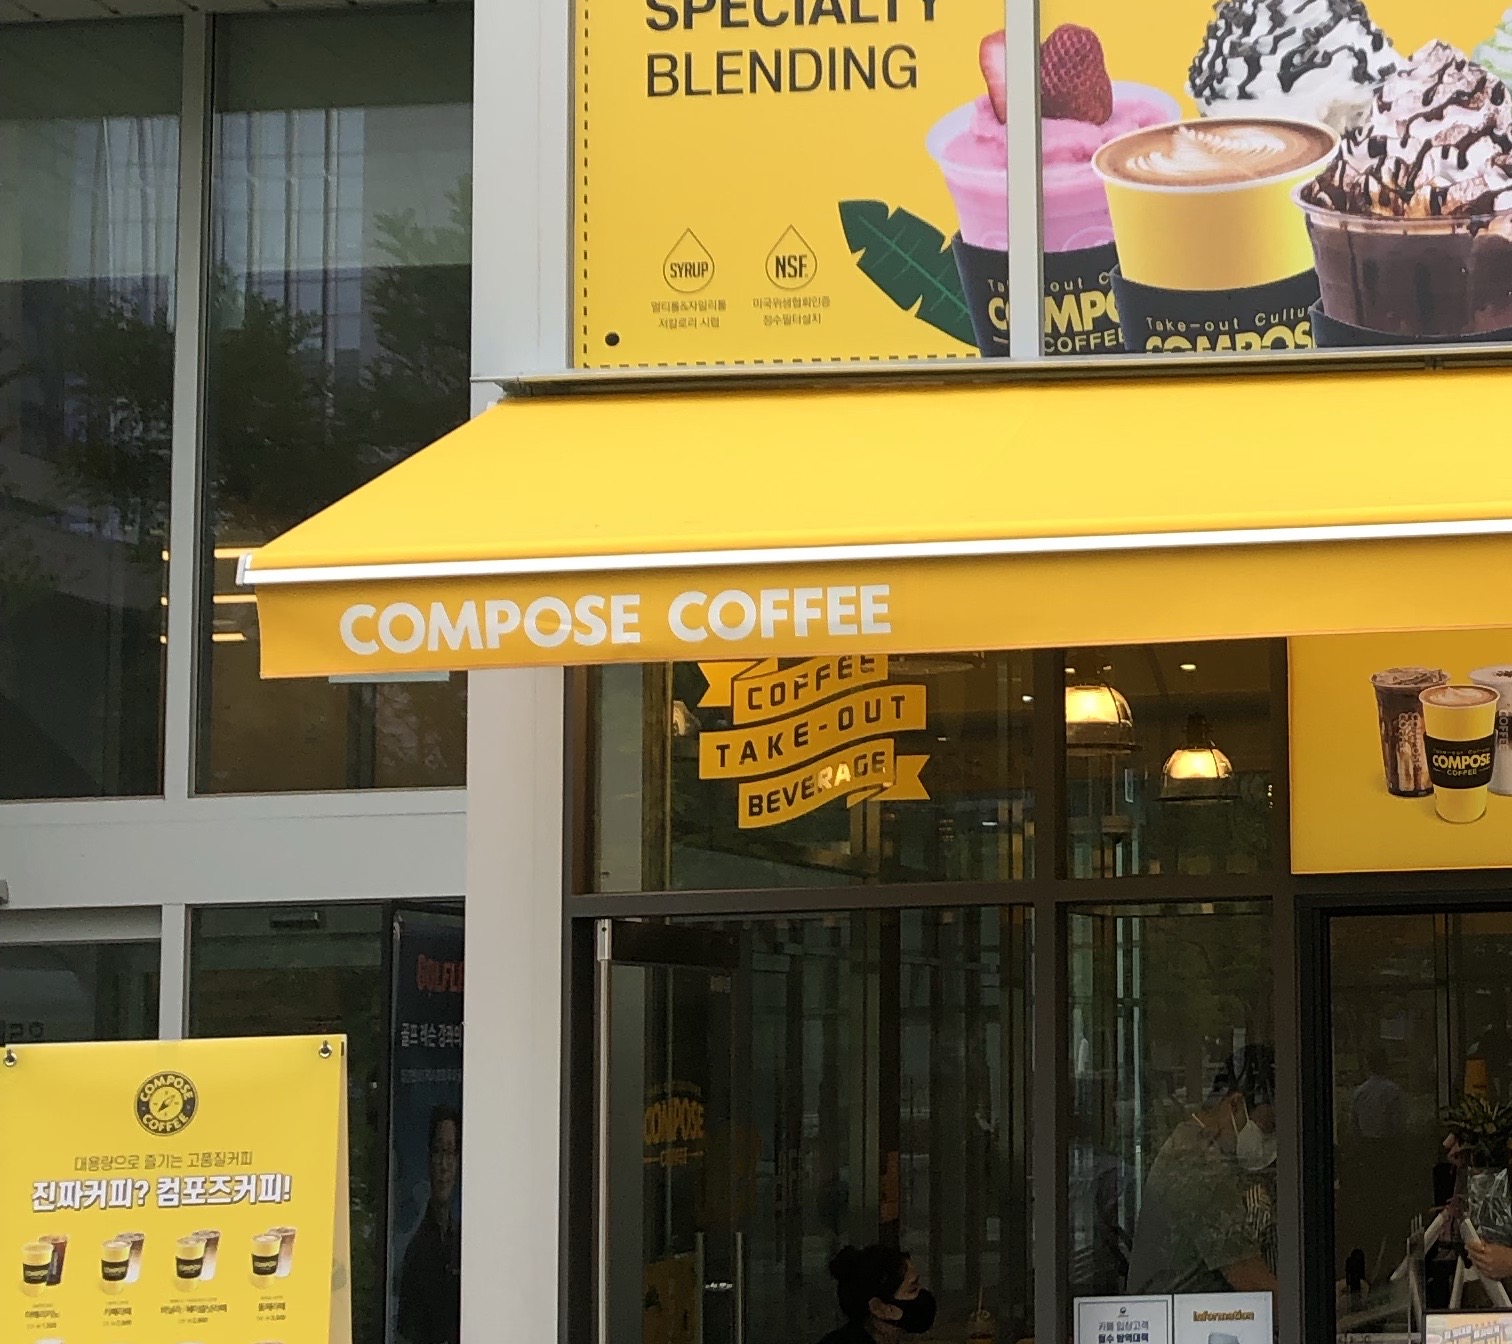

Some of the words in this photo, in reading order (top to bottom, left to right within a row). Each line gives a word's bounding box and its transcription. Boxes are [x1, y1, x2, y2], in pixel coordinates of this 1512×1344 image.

[646, 43, 918, 98] BLENDING
[669, 261, 709, 279] SYRUP
[339, 594, 641, 655] COMPOSE
[668, 583, 892, 642] COFFEE
[747, 655, 876, 711] COFFEE
[715, 695, 907, 768] TAKE-OUT
[1432, 752, 1491, 770] COMPOSE
[748, 751, 886, 818] BEVERAGE
[140, 1075, 194, 1103] COMPOSE
[142, 1113, 189, 1133] COFFEE
[155, 1173, 293, 1207] 컴포즈커피!
